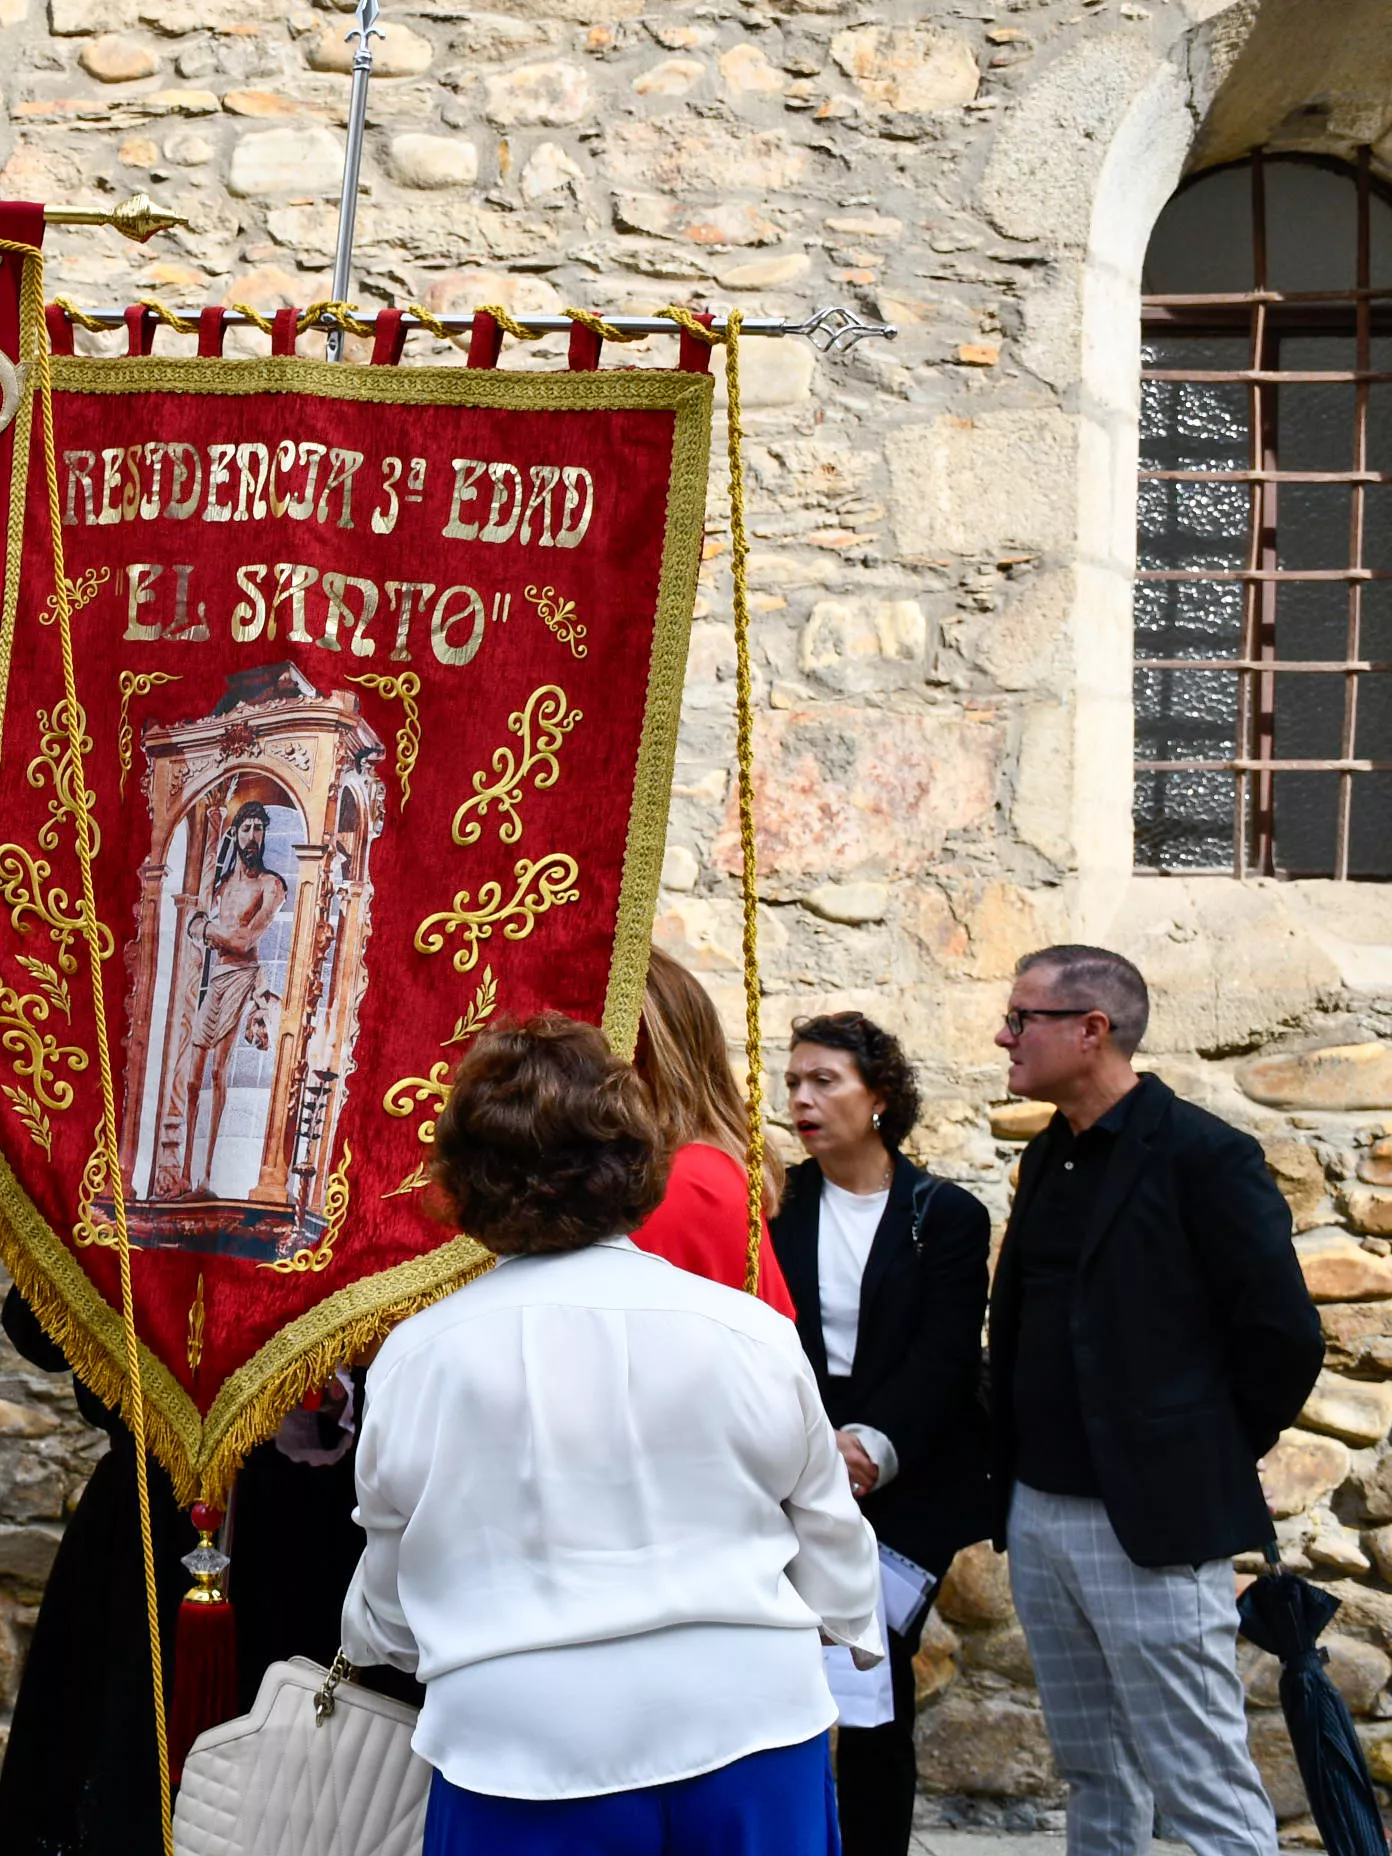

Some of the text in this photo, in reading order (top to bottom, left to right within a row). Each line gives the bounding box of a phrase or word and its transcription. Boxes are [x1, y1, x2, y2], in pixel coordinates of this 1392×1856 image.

[62, 441, 594, 549] RESIDENCIA 3ª EDAD
